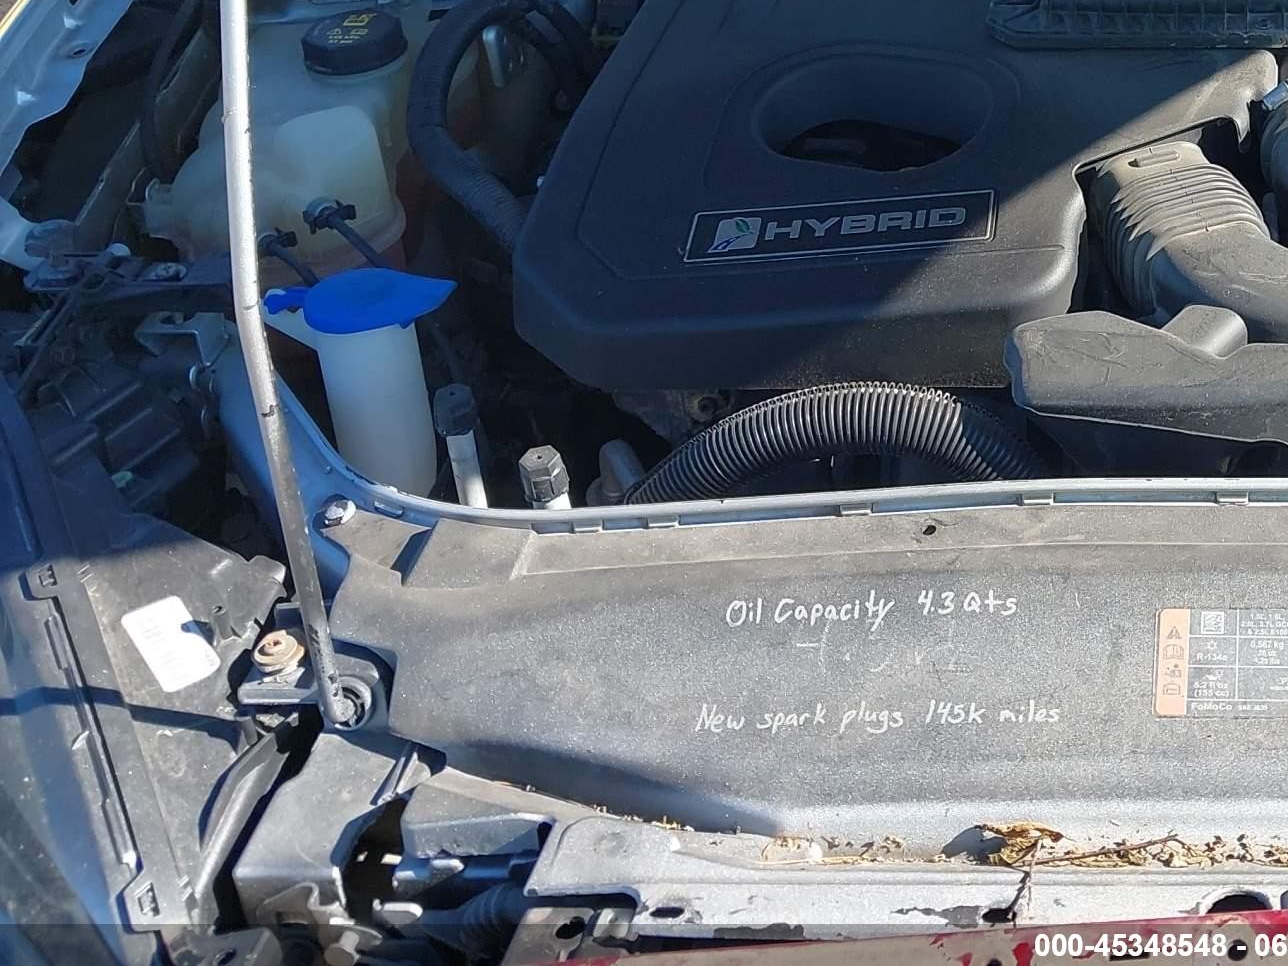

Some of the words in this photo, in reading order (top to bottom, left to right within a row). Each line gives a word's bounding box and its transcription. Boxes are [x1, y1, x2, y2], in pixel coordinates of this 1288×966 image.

[764, 207, 967, 241] HYBRID
[726, 598, 762, 627] Oil
[774, 590, 895, 632] Capacity
[917, 589, 956, 616] 4.3
[963, 589, 1018, 616] Qts
[695, 703, 745, 733] New
[756, 702, 827, 734] spark
[840, 700, 904, 734] plugs
[924, 699, 987, 724] 145k
[1000, 699, 1061, 723] miles
[1191, 702, 1233, 711] FoMoCo
